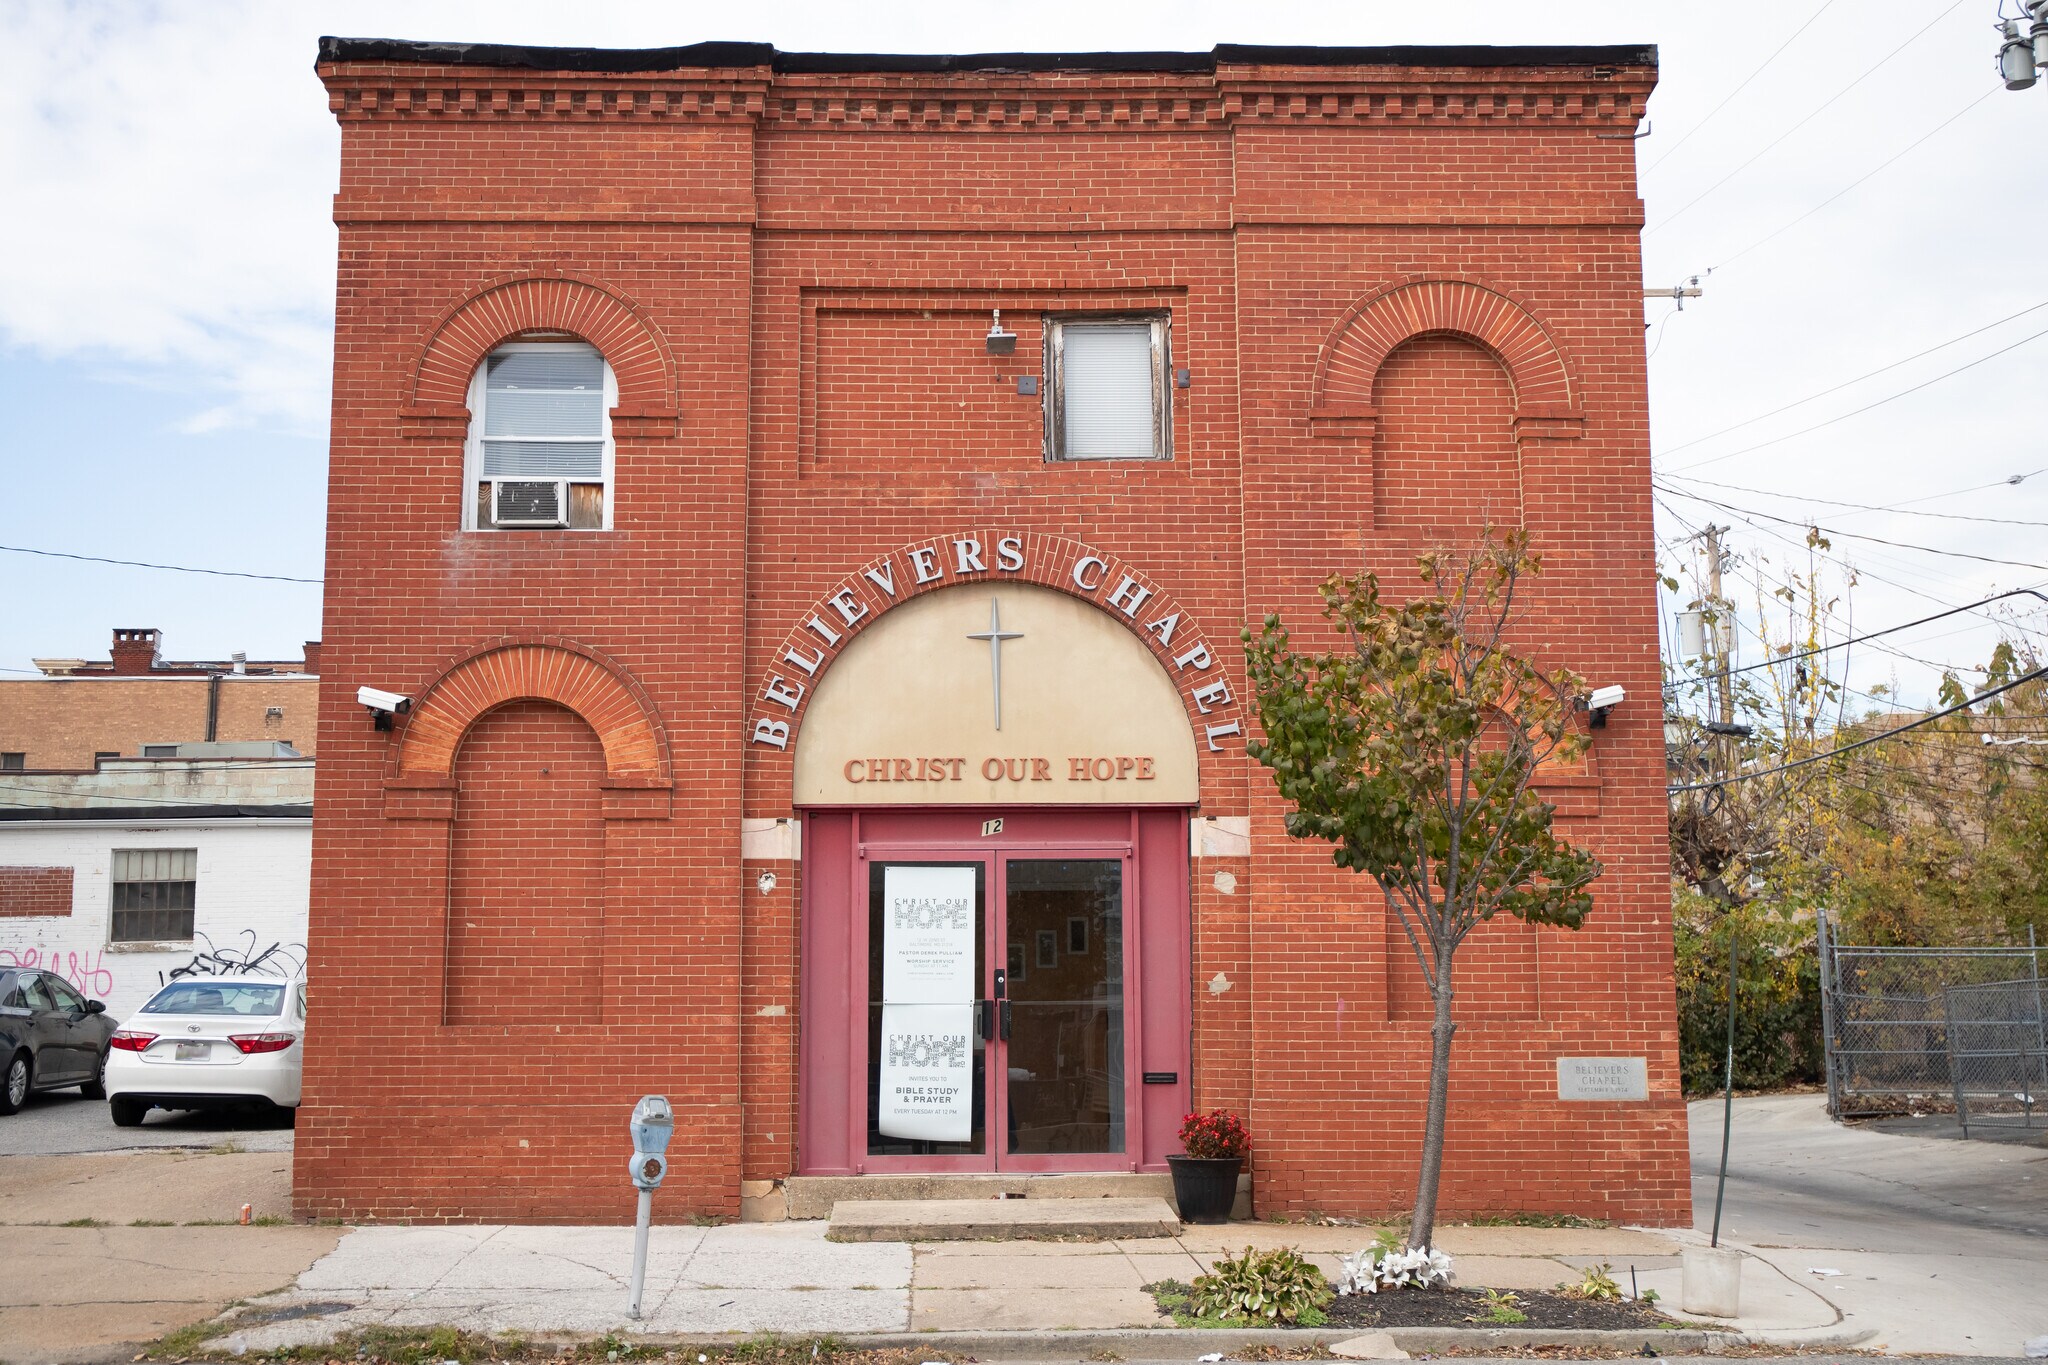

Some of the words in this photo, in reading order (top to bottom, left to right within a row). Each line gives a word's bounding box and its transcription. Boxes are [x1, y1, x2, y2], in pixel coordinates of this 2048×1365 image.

[752, 537, 1025, 751] BELIEVERS
[1073, 556, 1241, 752] CHAPEL
[843, 757, 967, 784] CHRIST
[981, 756, 1053, 783] OUR
[1067, 755, 1157, 782] HOPE
[985, 819, 1002, 835] 12
[894, 904, 968, 929] HOPE
[889, 1040, 966, 1068] HOPE
[1575, 1066, 1629, 1075] BELIEVERS
[1581, 1076, 1623, 1085] CHAPEL
